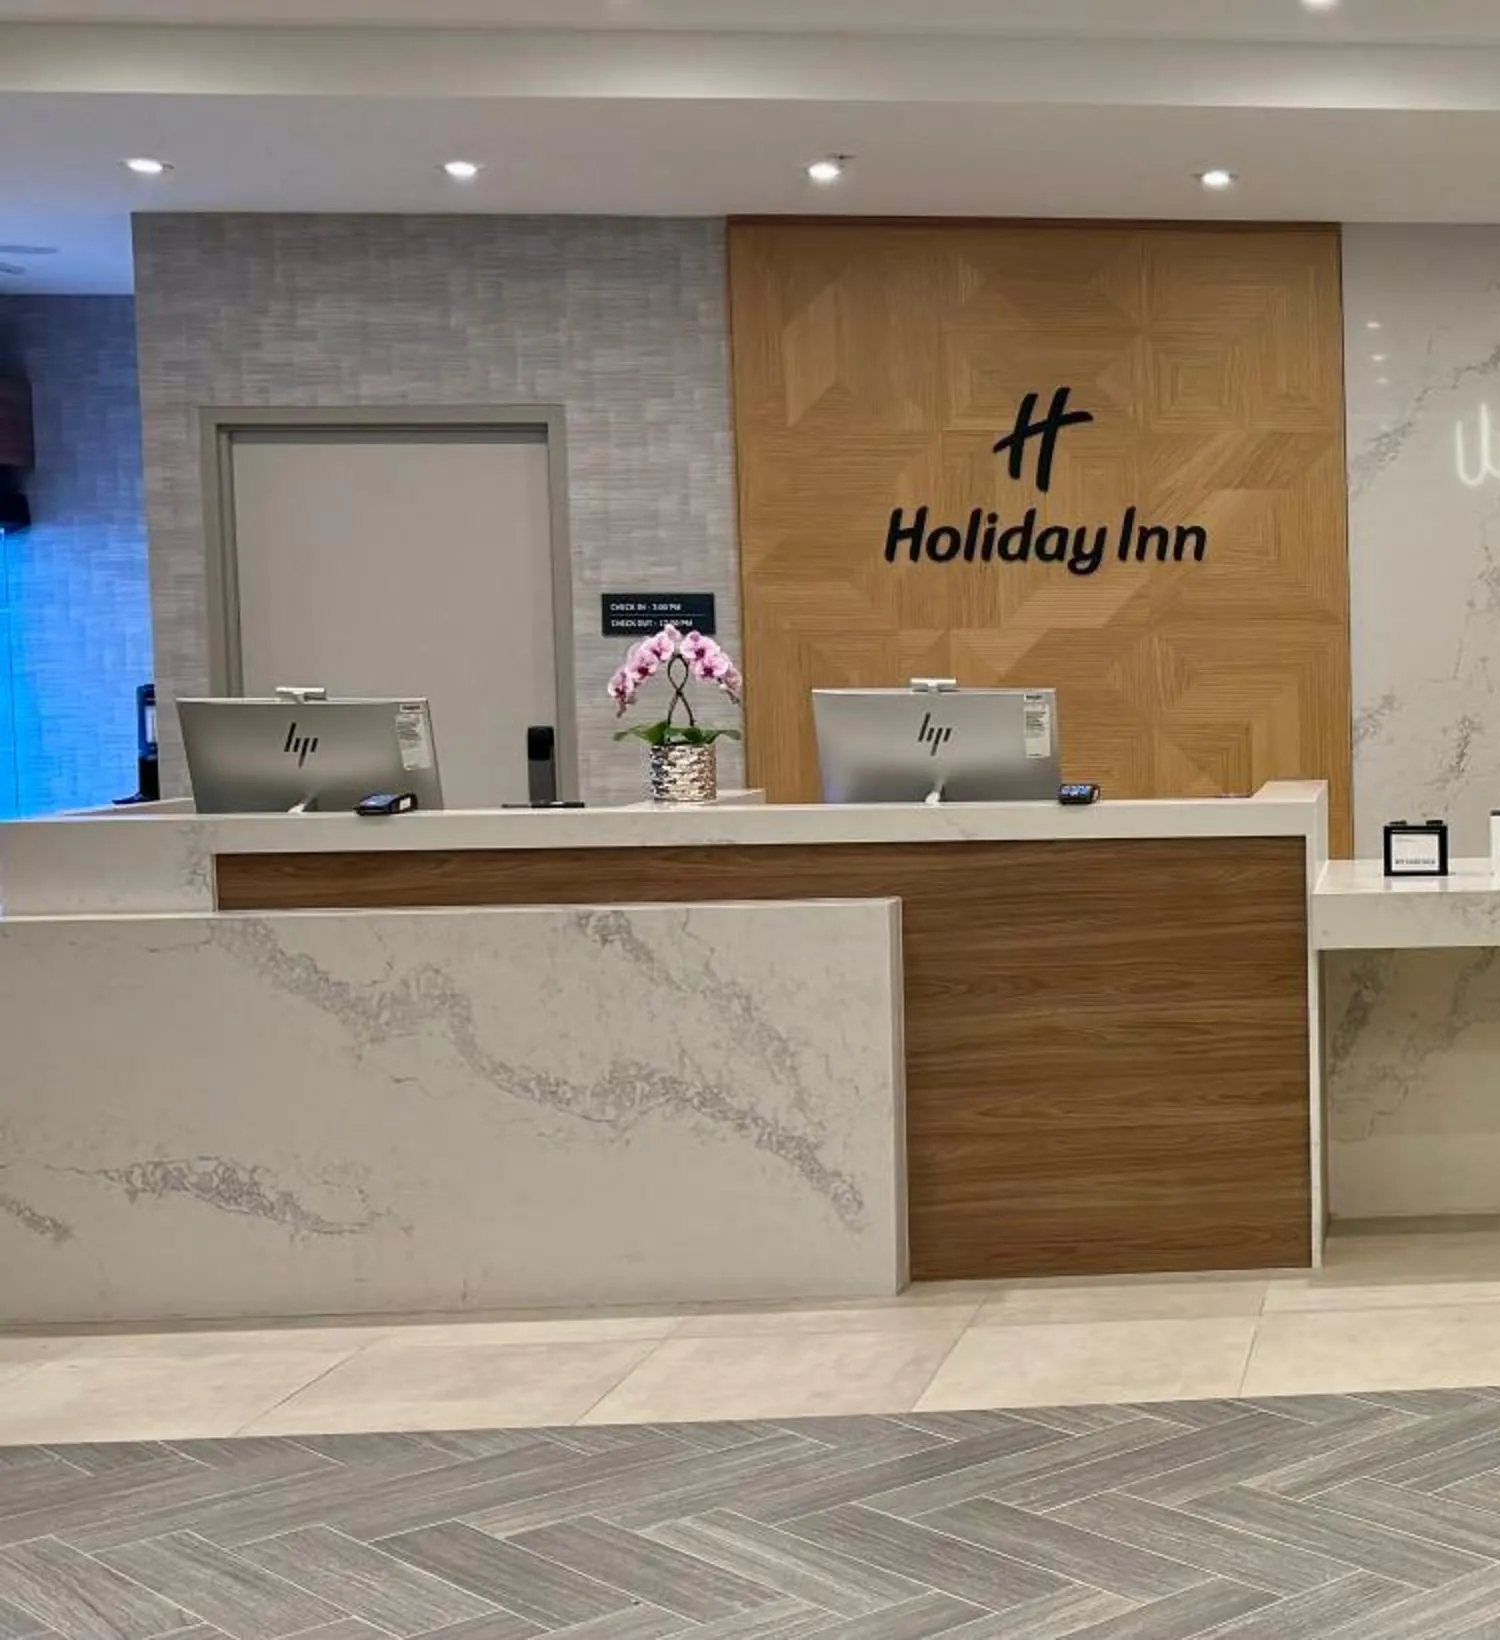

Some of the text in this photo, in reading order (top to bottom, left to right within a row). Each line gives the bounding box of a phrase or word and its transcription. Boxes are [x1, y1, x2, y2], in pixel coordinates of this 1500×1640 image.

[884, 505, 1207, 576] Holiday Inn
[610, 603, 635, 611] CHECK
[637, 603, 647, 611] IN
[669, 603, 682, 611] PM
[611, 619, 636, 627] CHECK
[637, 619, 653, 627] OUT
[680, 619, 693, 627] PM
